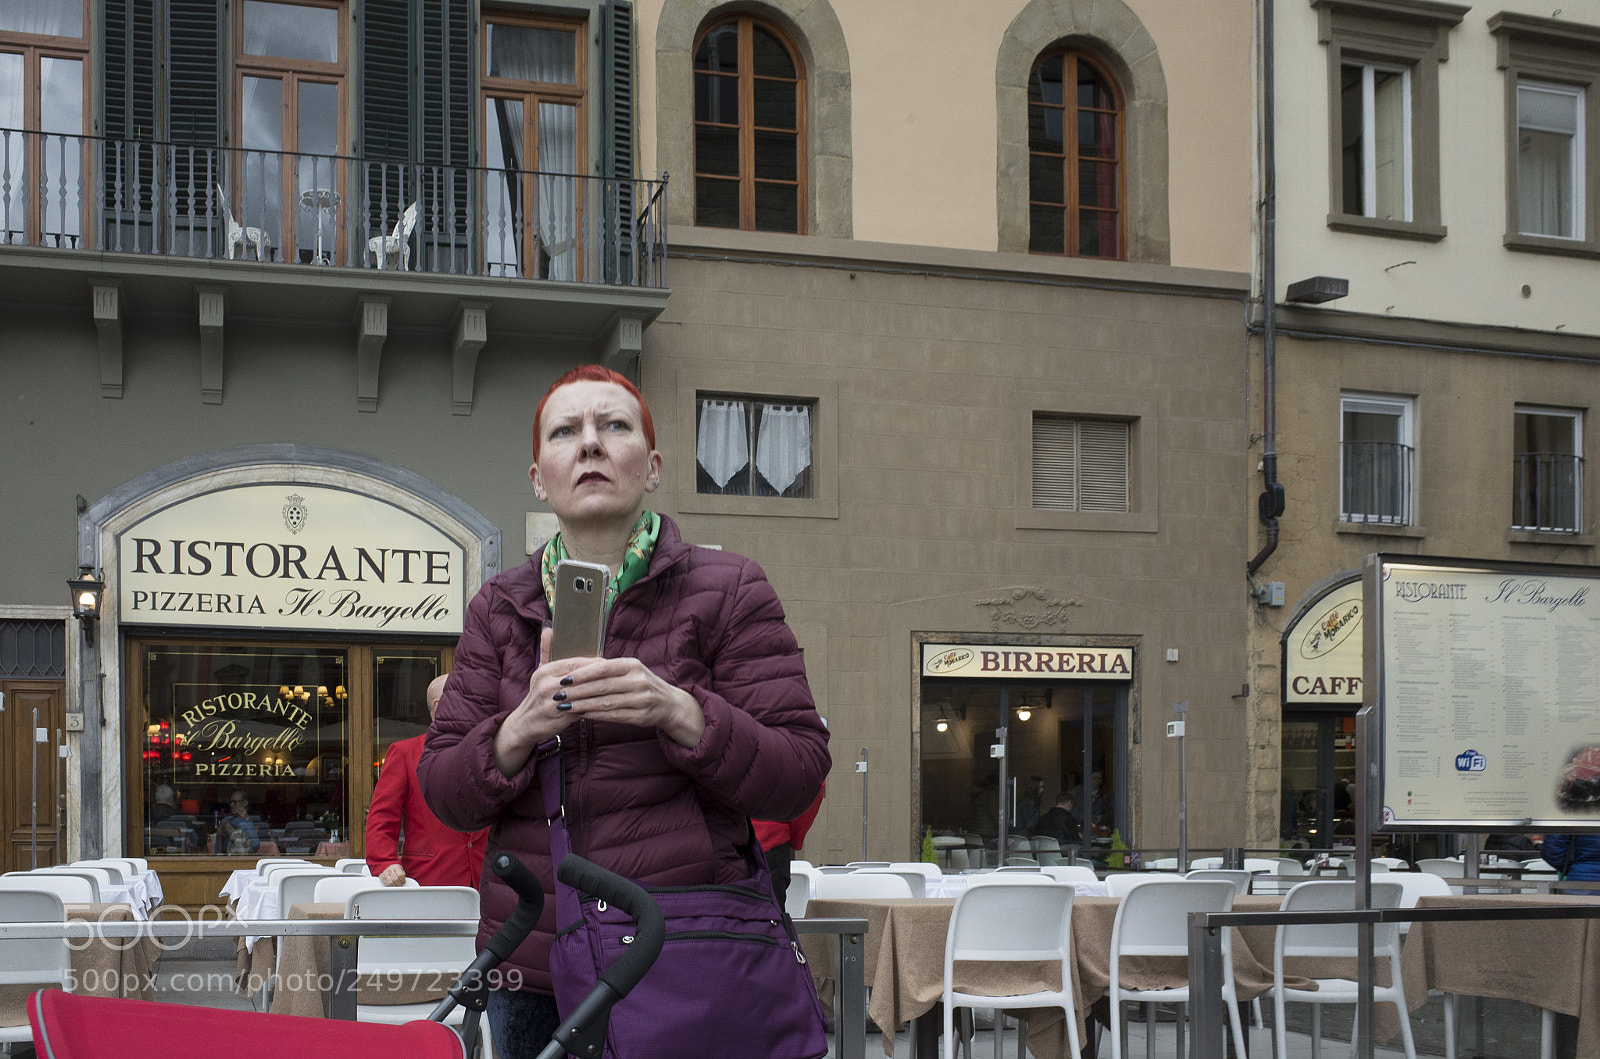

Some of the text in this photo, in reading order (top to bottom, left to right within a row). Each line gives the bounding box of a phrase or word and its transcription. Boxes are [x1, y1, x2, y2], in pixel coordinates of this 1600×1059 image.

[131, 538, 450, 584] RISTORANTE
[131, 587, 450, 628] PIZZERIA Il Bargello
[1395, 579, 1590, 612] RISTORANTE Il Bargello
[980, 651, 1130, 674] BIRRERIA
[70, 716, 79, 728] 3
[181, 692, 313, 730] RISTORANTE
[198, 720, 306, 756] Bargello
[195, 763, 296, 777] PIZZERIA
